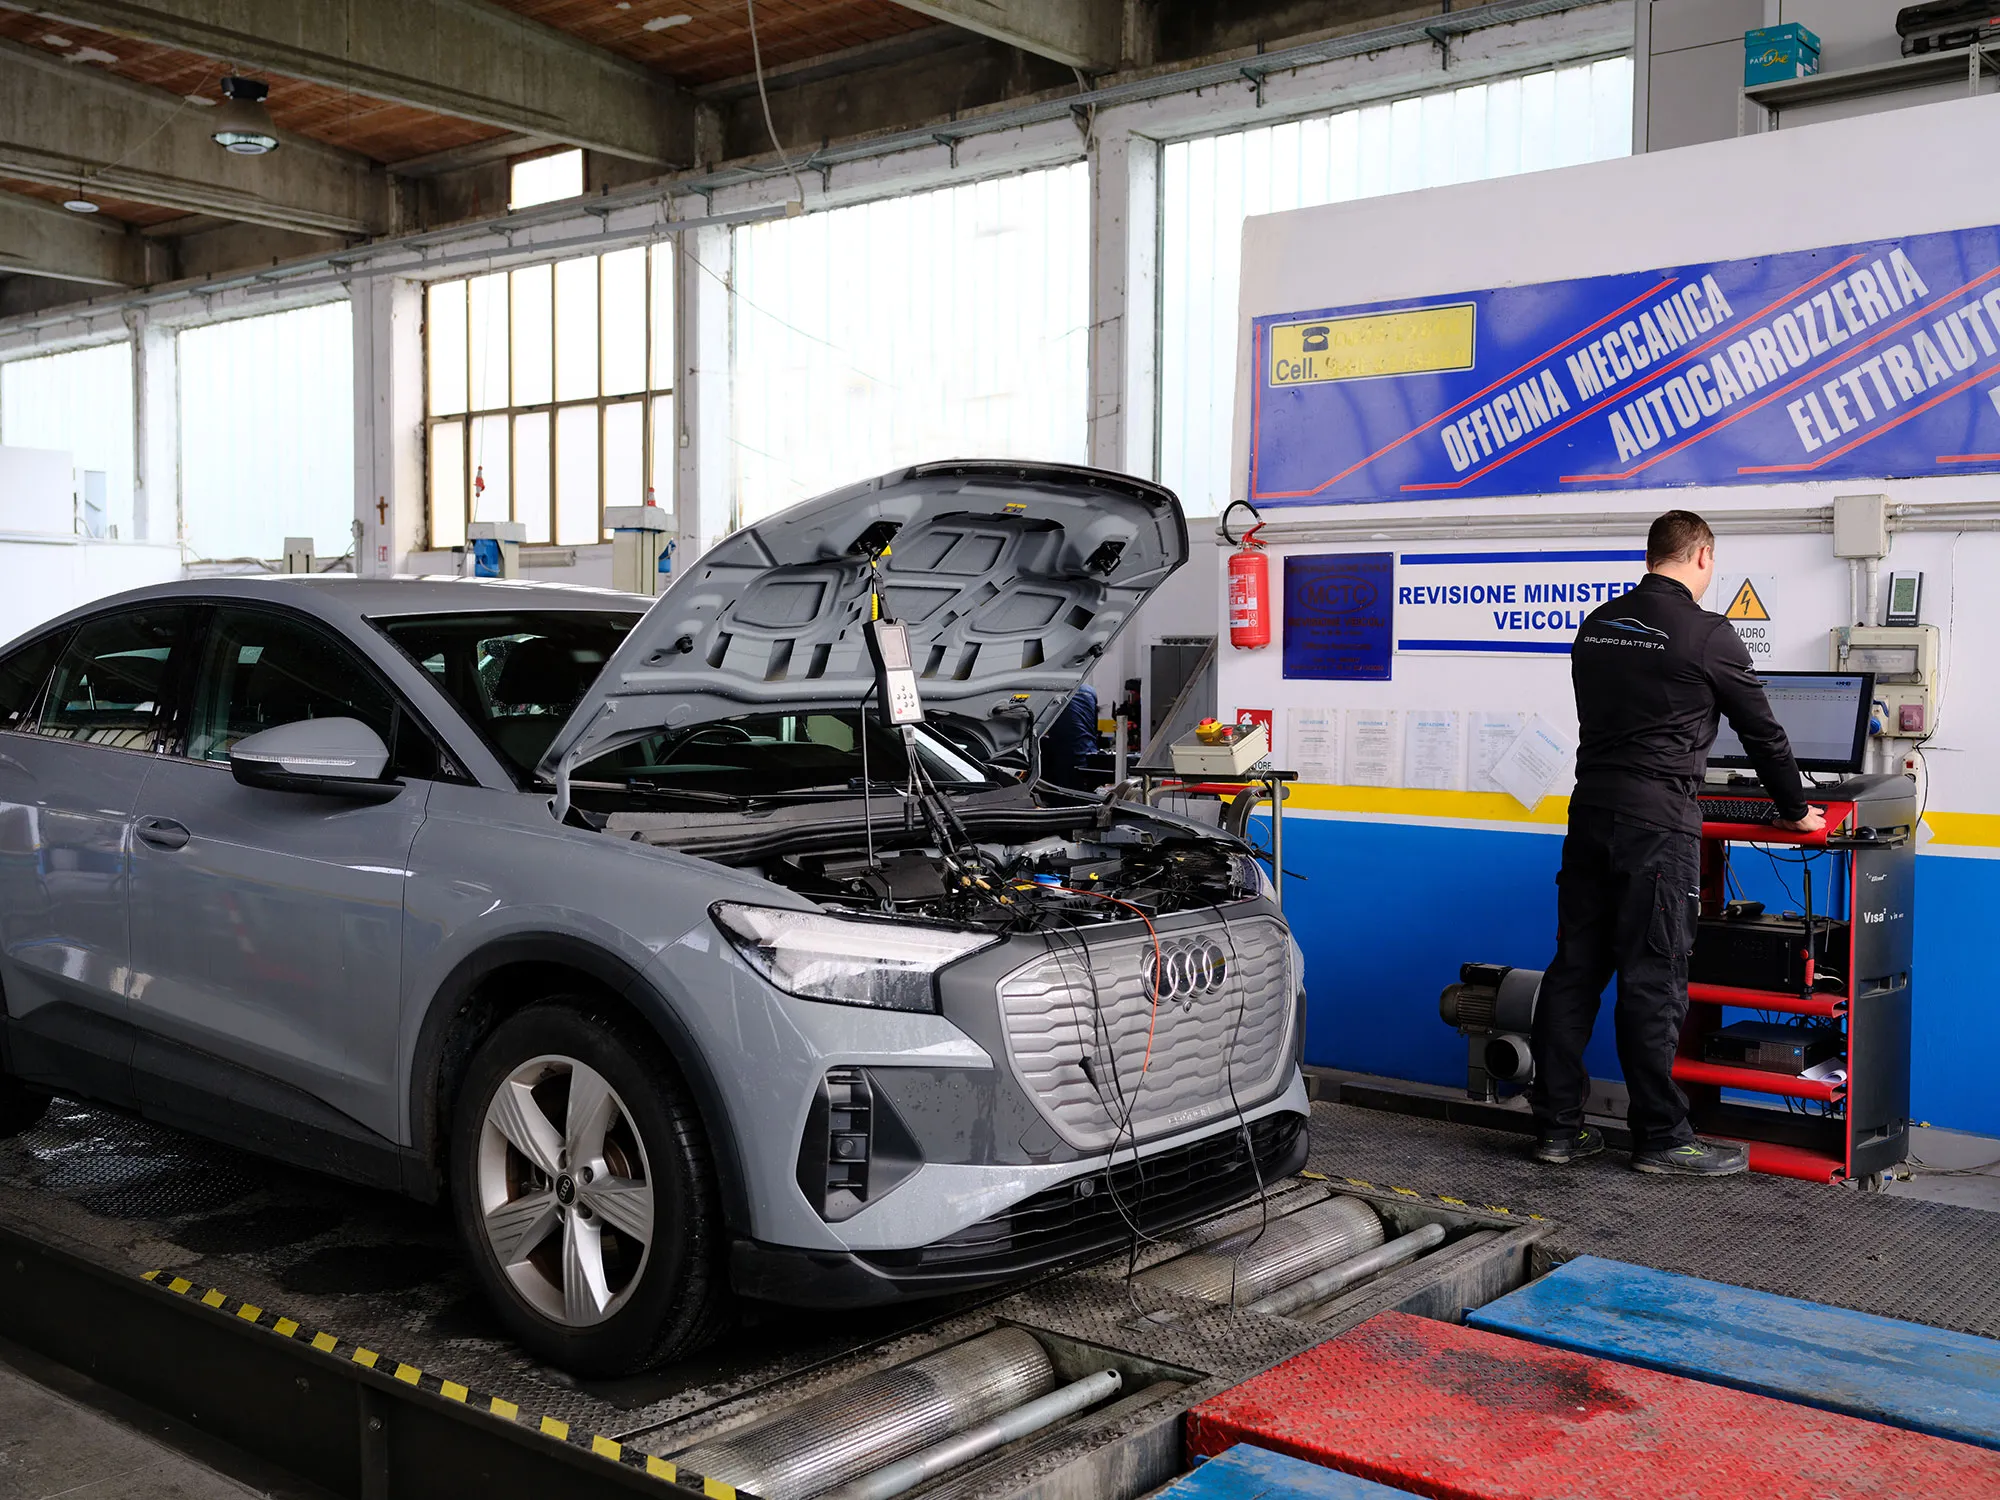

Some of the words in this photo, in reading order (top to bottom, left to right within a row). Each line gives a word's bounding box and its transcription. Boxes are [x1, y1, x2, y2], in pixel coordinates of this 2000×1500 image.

[1607, 247, 1930, 463] AUTOCARROZZERIA
[1275, 357, 1319, 381] Cell.
[1440, 368, 1571, 472] OFFICINA
[1565, 273, 1734, 402] MECCANICA
[1307, 584, 1368, 605] MCTC
[1399, 585, 1517, 605] REVISIONE
[1584, 636, 1620, 646] GRUPPO
[1620, 640, 1666, 651] BATTISTA
[1736, 627, 1766, 639] ADRO
